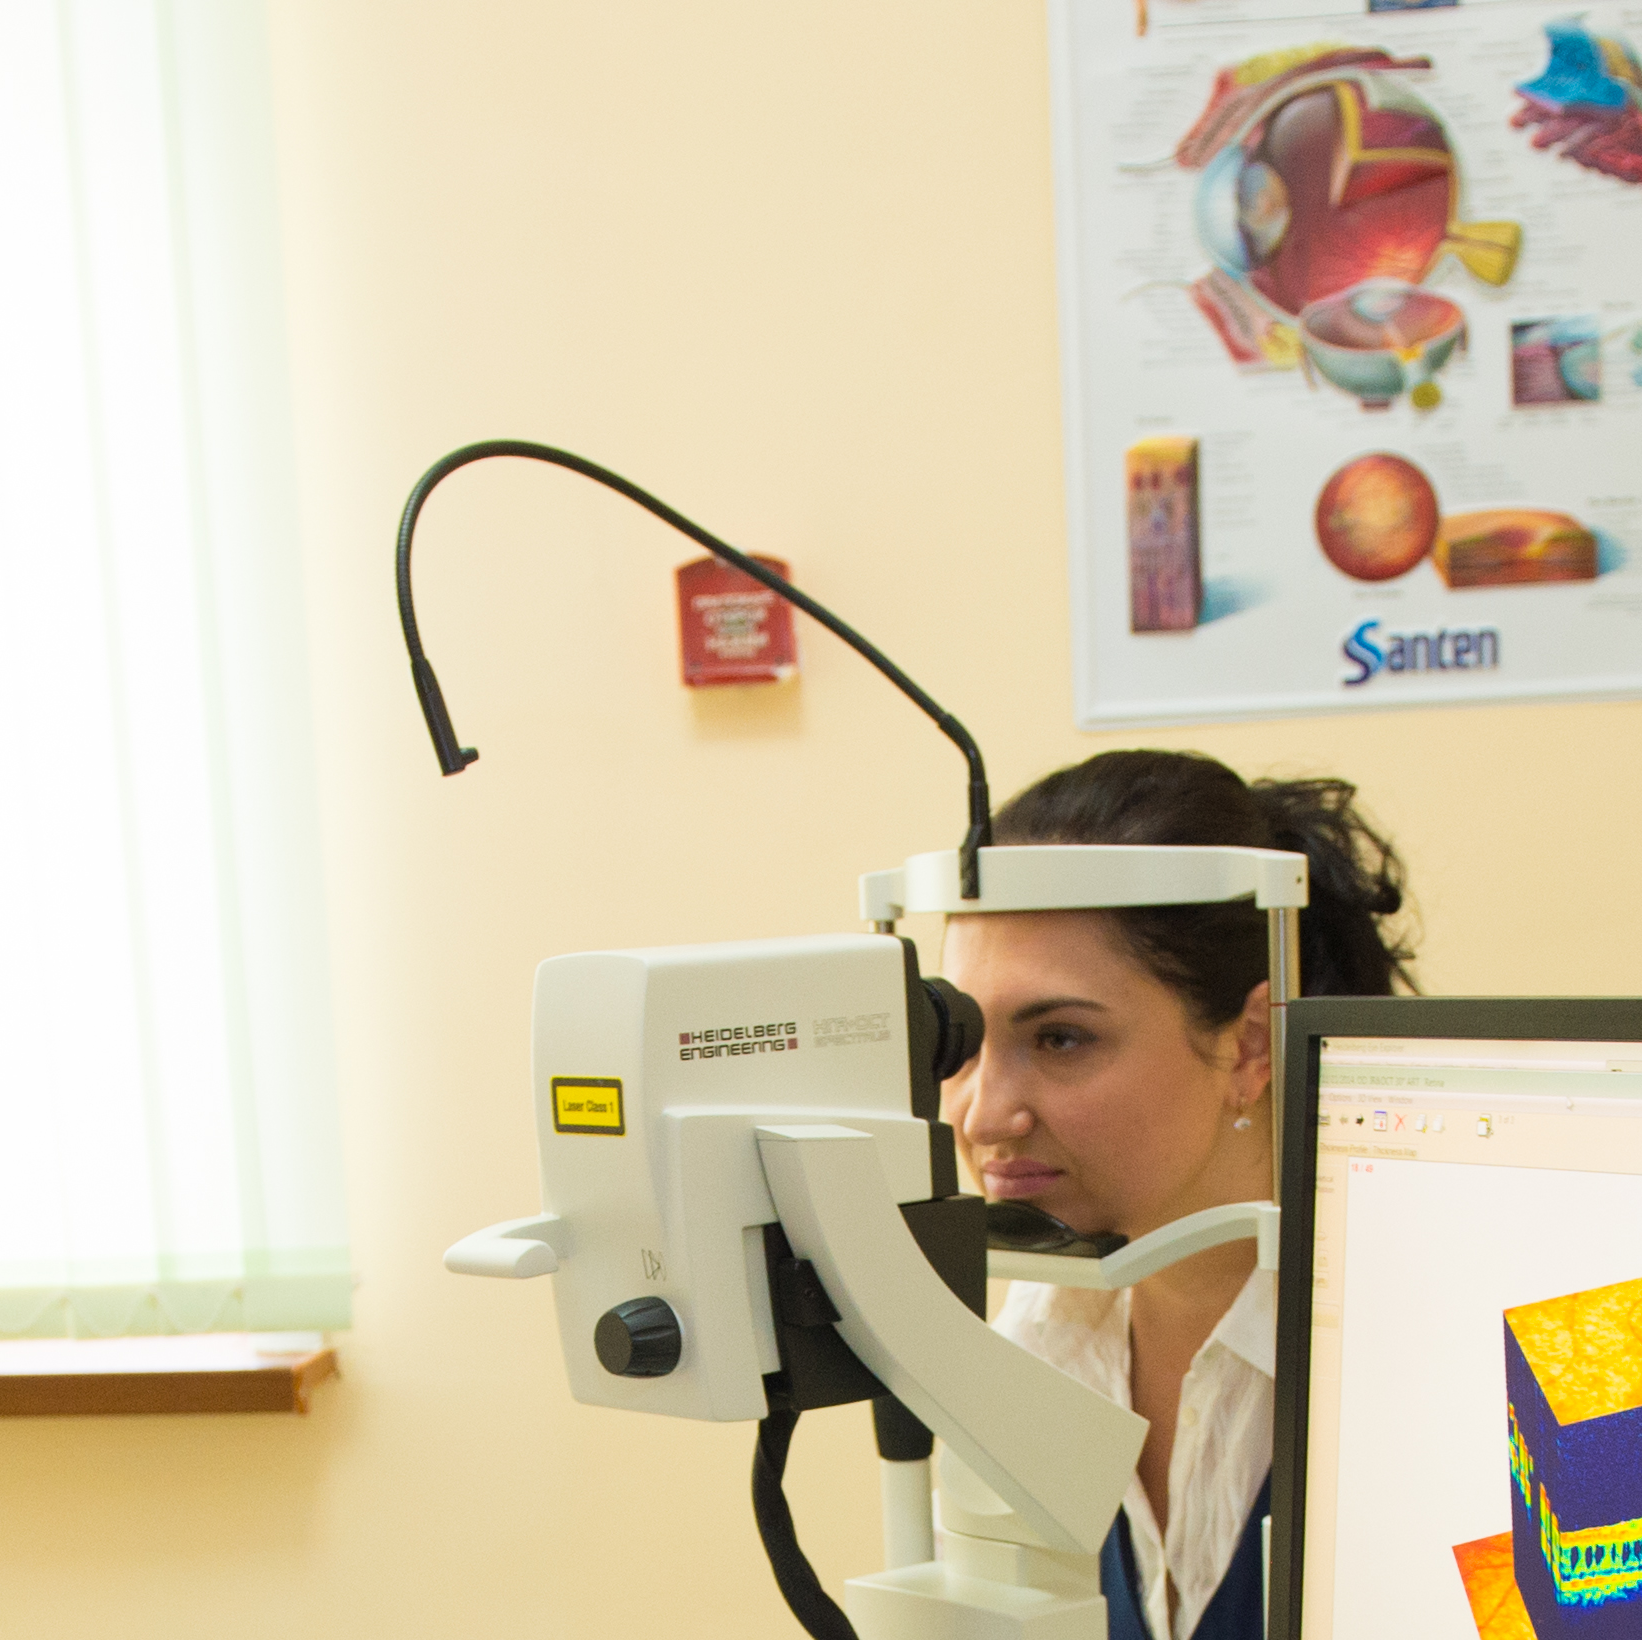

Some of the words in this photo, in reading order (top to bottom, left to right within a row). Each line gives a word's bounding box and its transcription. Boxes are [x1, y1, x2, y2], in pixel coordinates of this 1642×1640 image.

[1342, 618, 1499, 688] Santen
[690, 1022, 796, 1044] HEIDELBERG
[679, 1039, 785, 1061] ENGINEERING
[563, 1099, 584, 1112] Laser
[586, 1100, 607, 1113] Class
